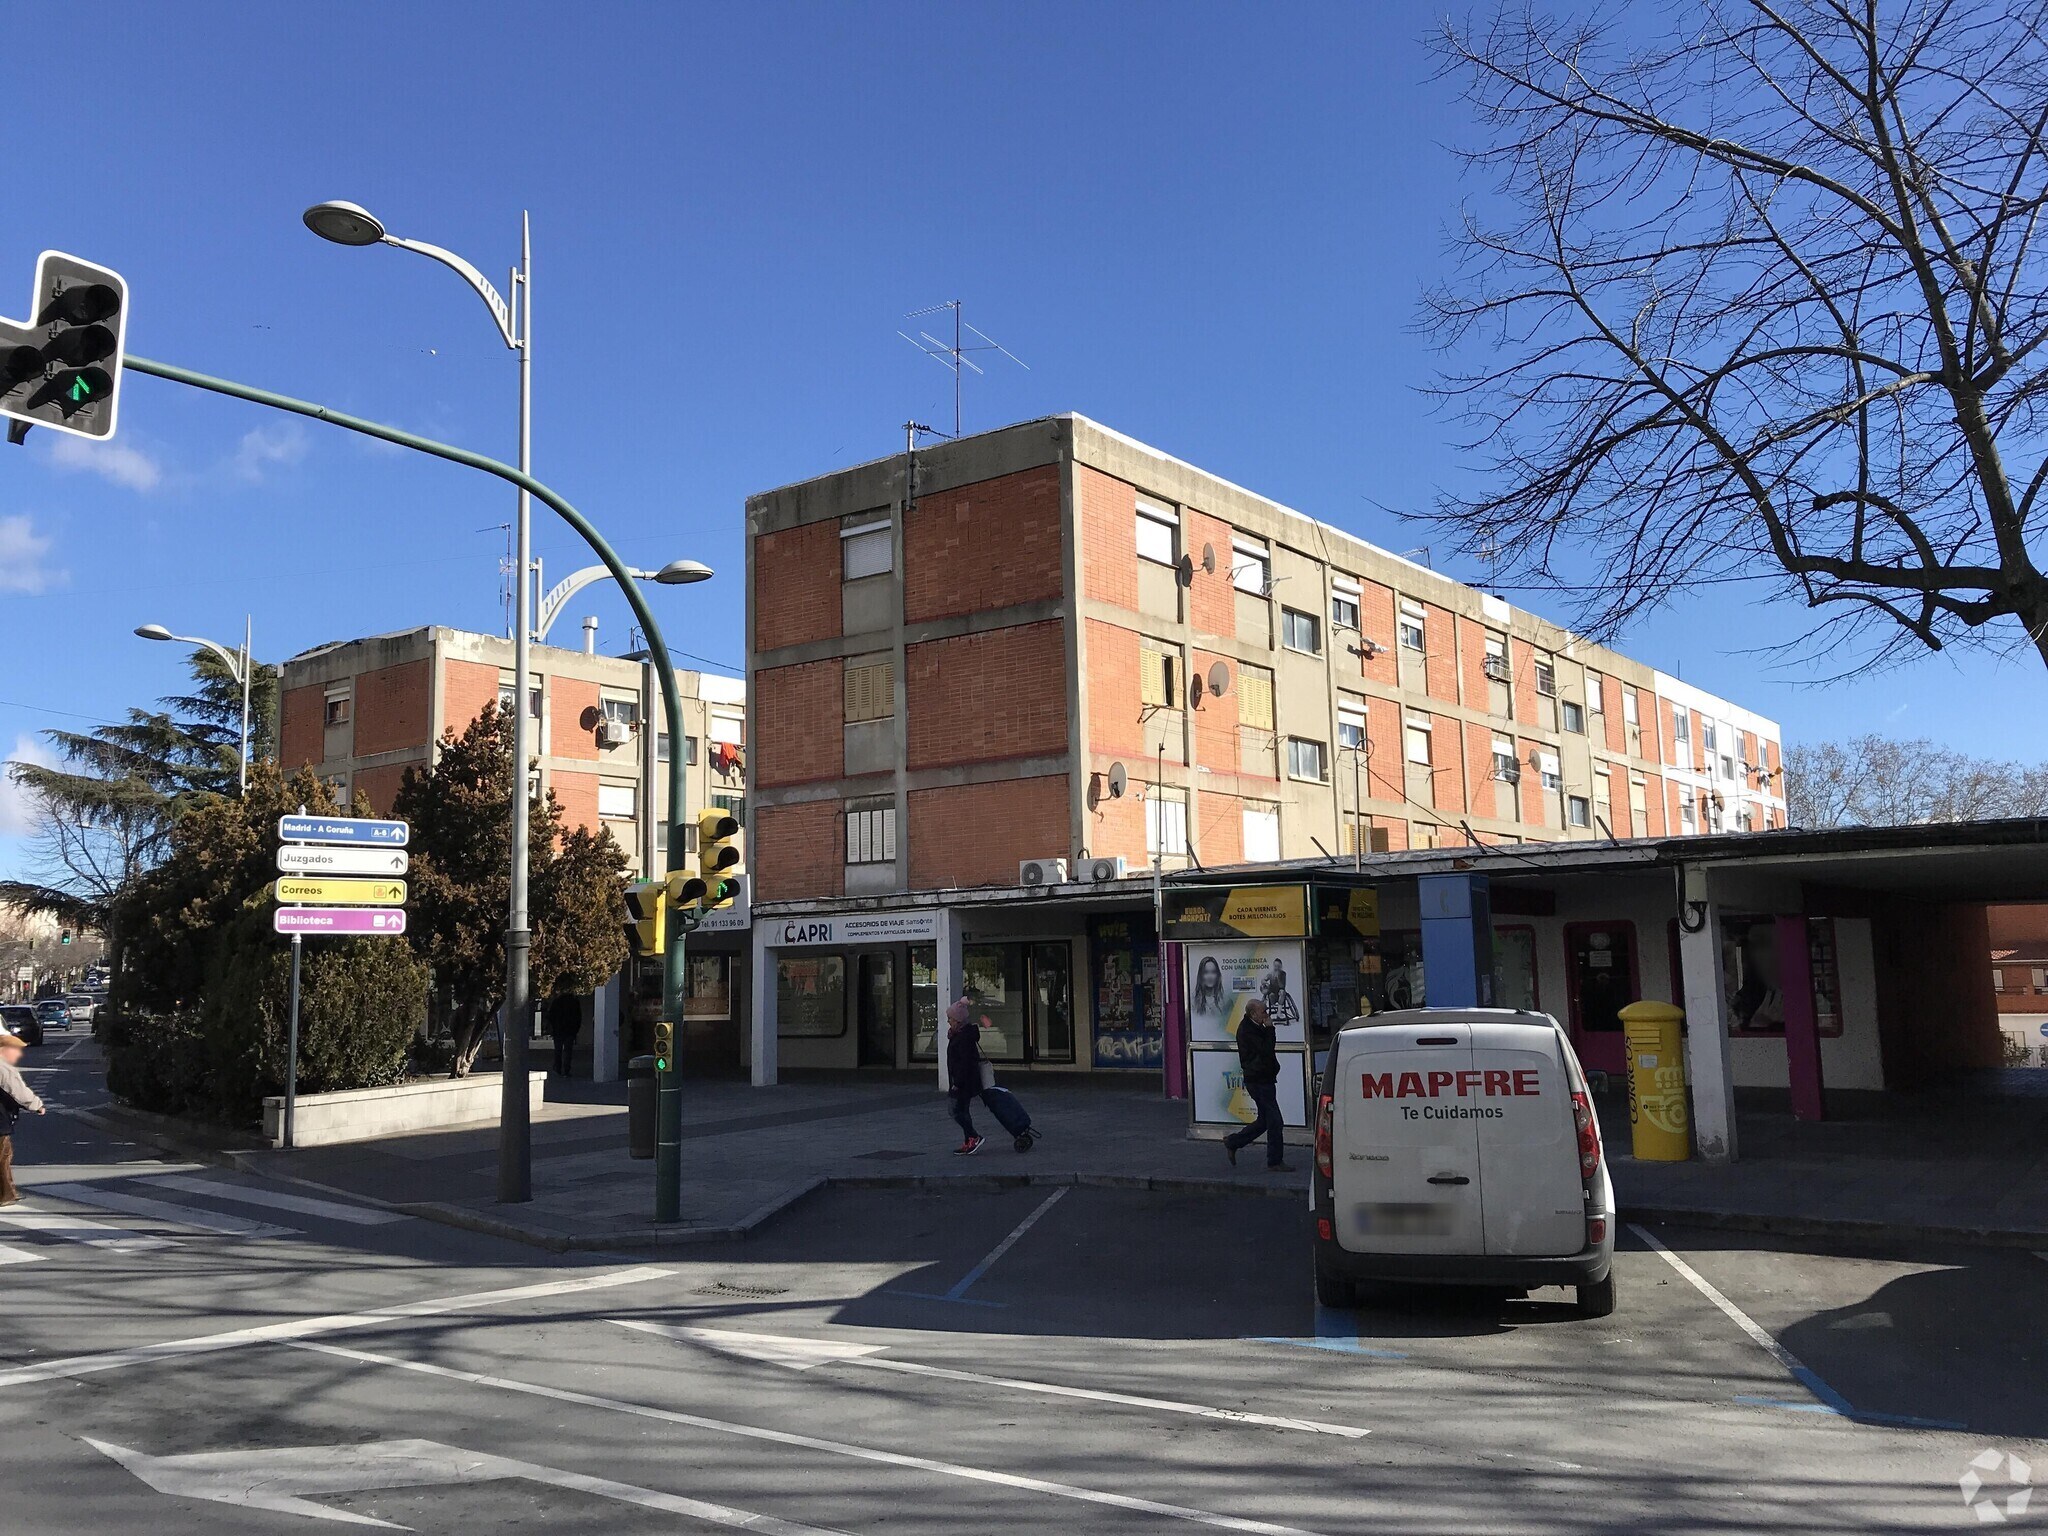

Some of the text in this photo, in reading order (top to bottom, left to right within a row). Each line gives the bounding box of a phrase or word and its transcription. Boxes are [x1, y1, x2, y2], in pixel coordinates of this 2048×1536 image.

[284, 823, 312, 832] Madrid
[326, 825, 354, 834] Coruña
[284, 854, 333, 864] Juzgados
[281, 885, 322, 895] Correos
[279, 916, 333, 925] Biblioteca
[1247, 912, 1287, 920] MILLONARIOS
[845, 920, 880, 928] ACCESORIOS
[784, 921, 832, 944] CAPRI
[1362, 1070, 1540, 1098] MAPFRE
[1401, 1105, 1504, 1120] Te Cuidamos
